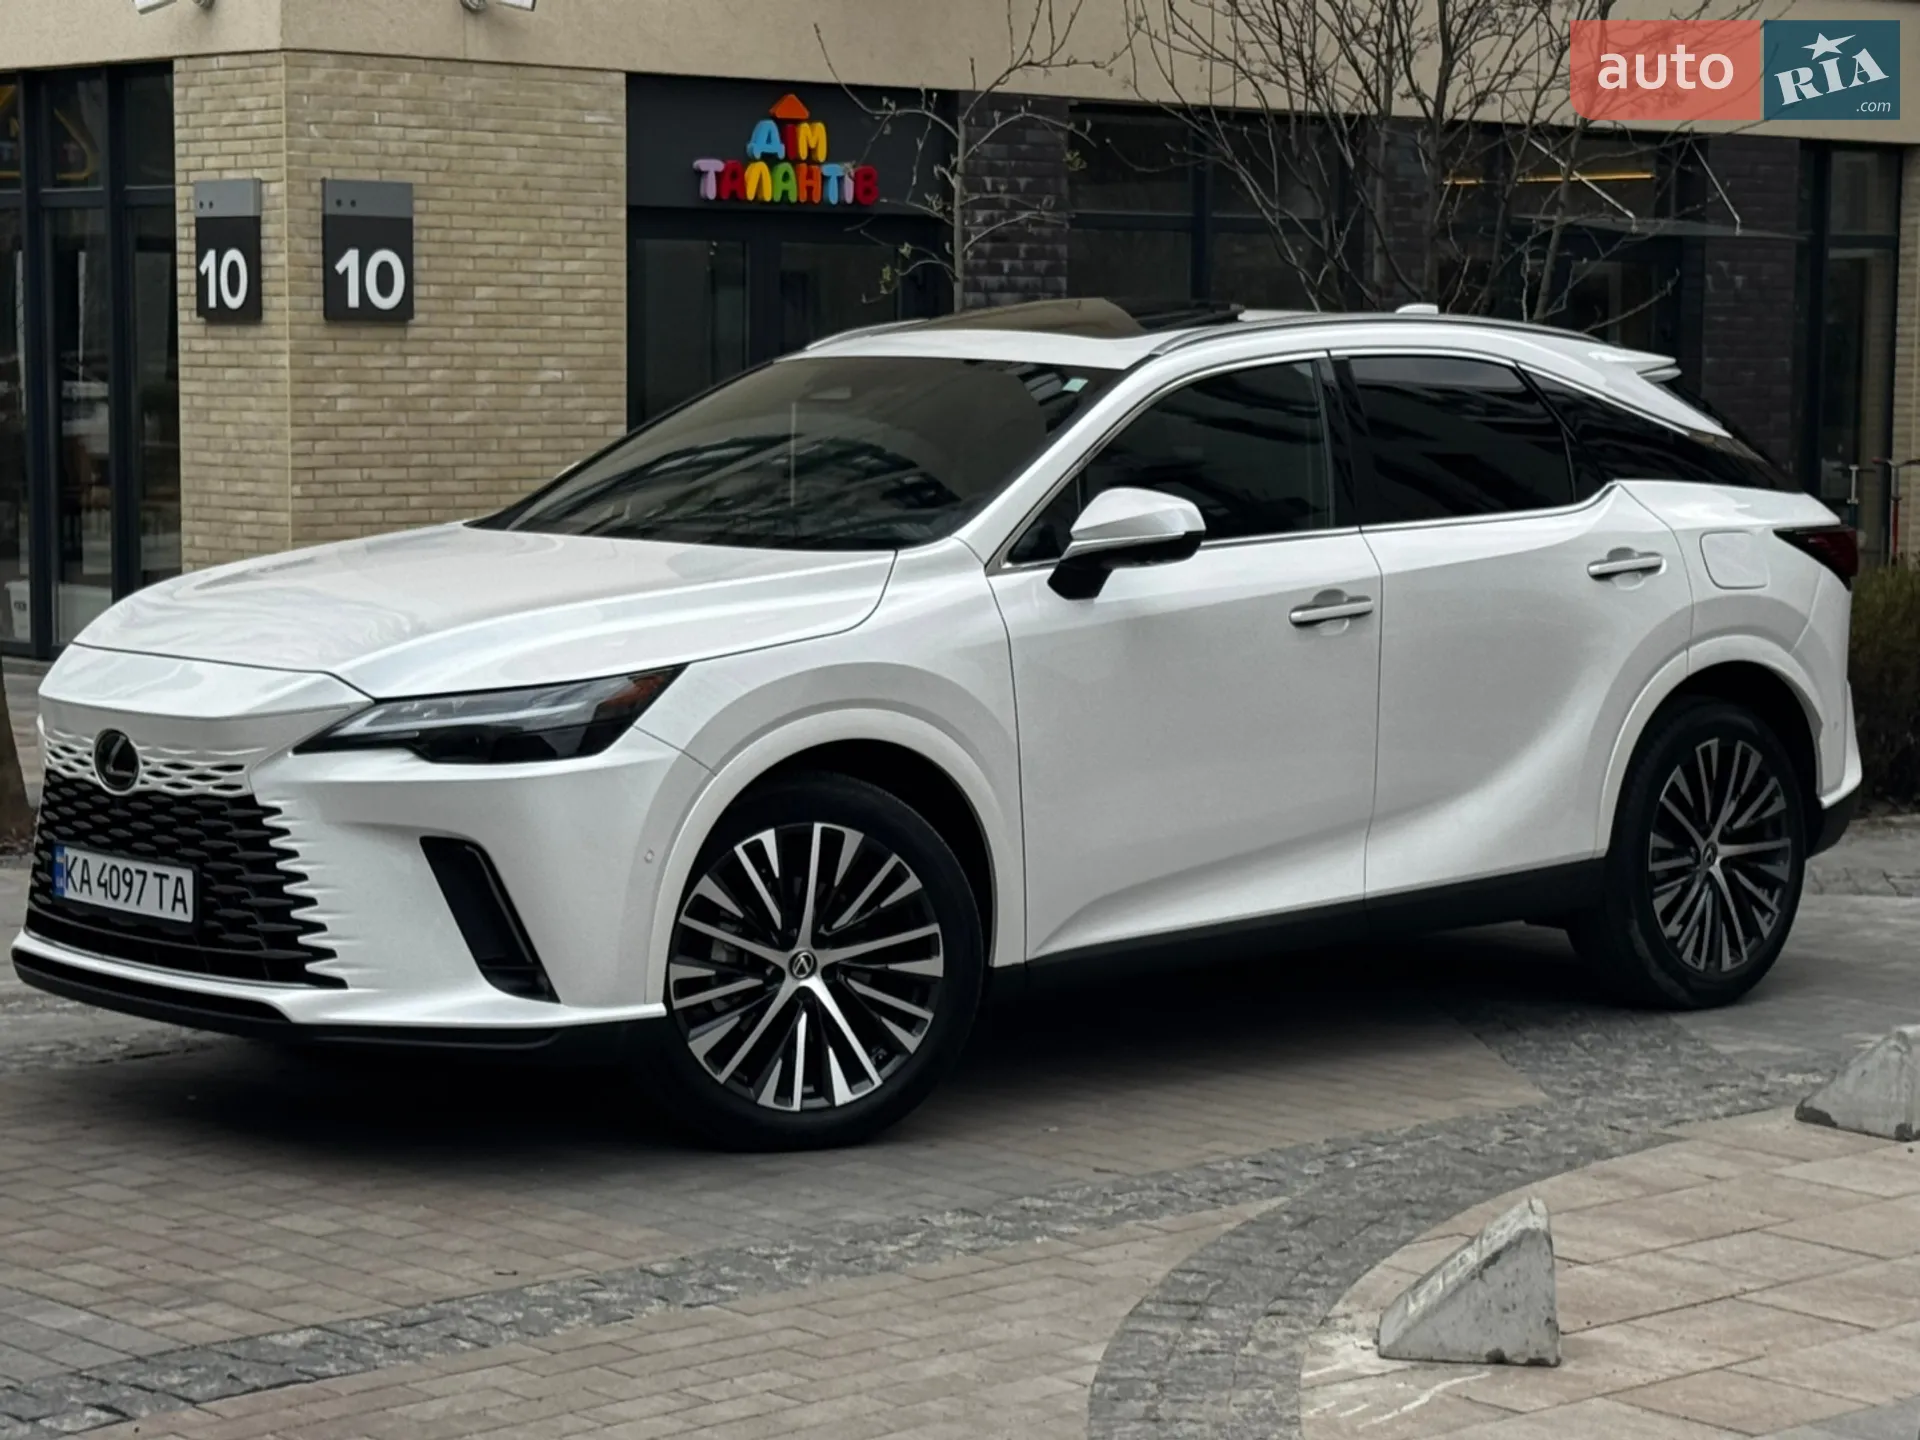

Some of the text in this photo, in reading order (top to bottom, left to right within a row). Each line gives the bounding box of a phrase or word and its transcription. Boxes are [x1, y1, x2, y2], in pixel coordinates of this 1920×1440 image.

[747, 120, 827, 162] ДІМ
[693, 159, 879, 205] ТАЛАНТІВ
[199, 248, 248, 309] 10
[335, 248, 405, 310] 10
[65, 855, 188, 914] KA 4097 TA
